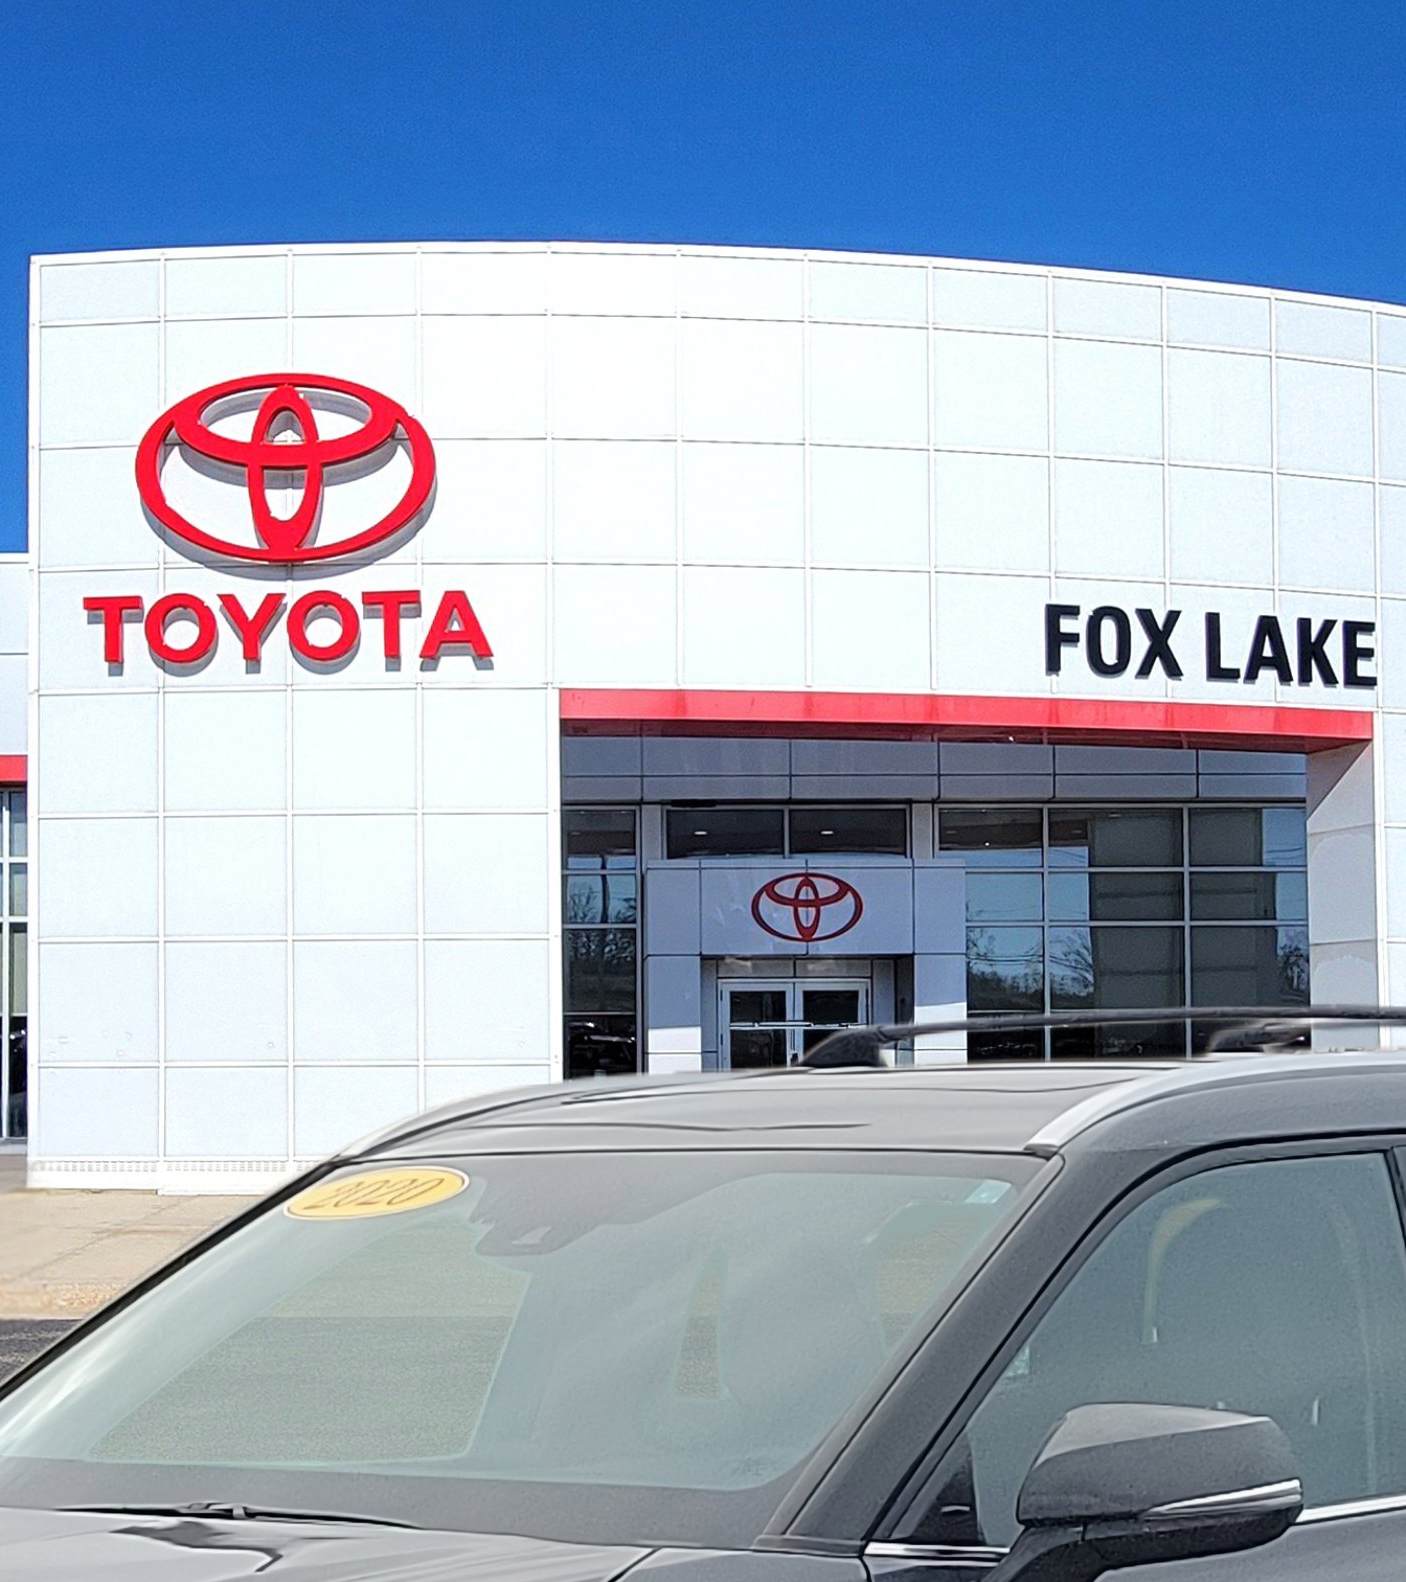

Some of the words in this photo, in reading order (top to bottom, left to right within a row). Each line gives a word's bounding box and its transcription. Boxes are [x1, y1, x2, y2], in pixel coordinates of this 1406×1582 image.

[83, 589, 494, 670] TOYOTA
[1044, 602, 1185, 679] FOX
[1204, 610, 1378, 687] LAKE
[302, 1176, 446, 1211] 2020
